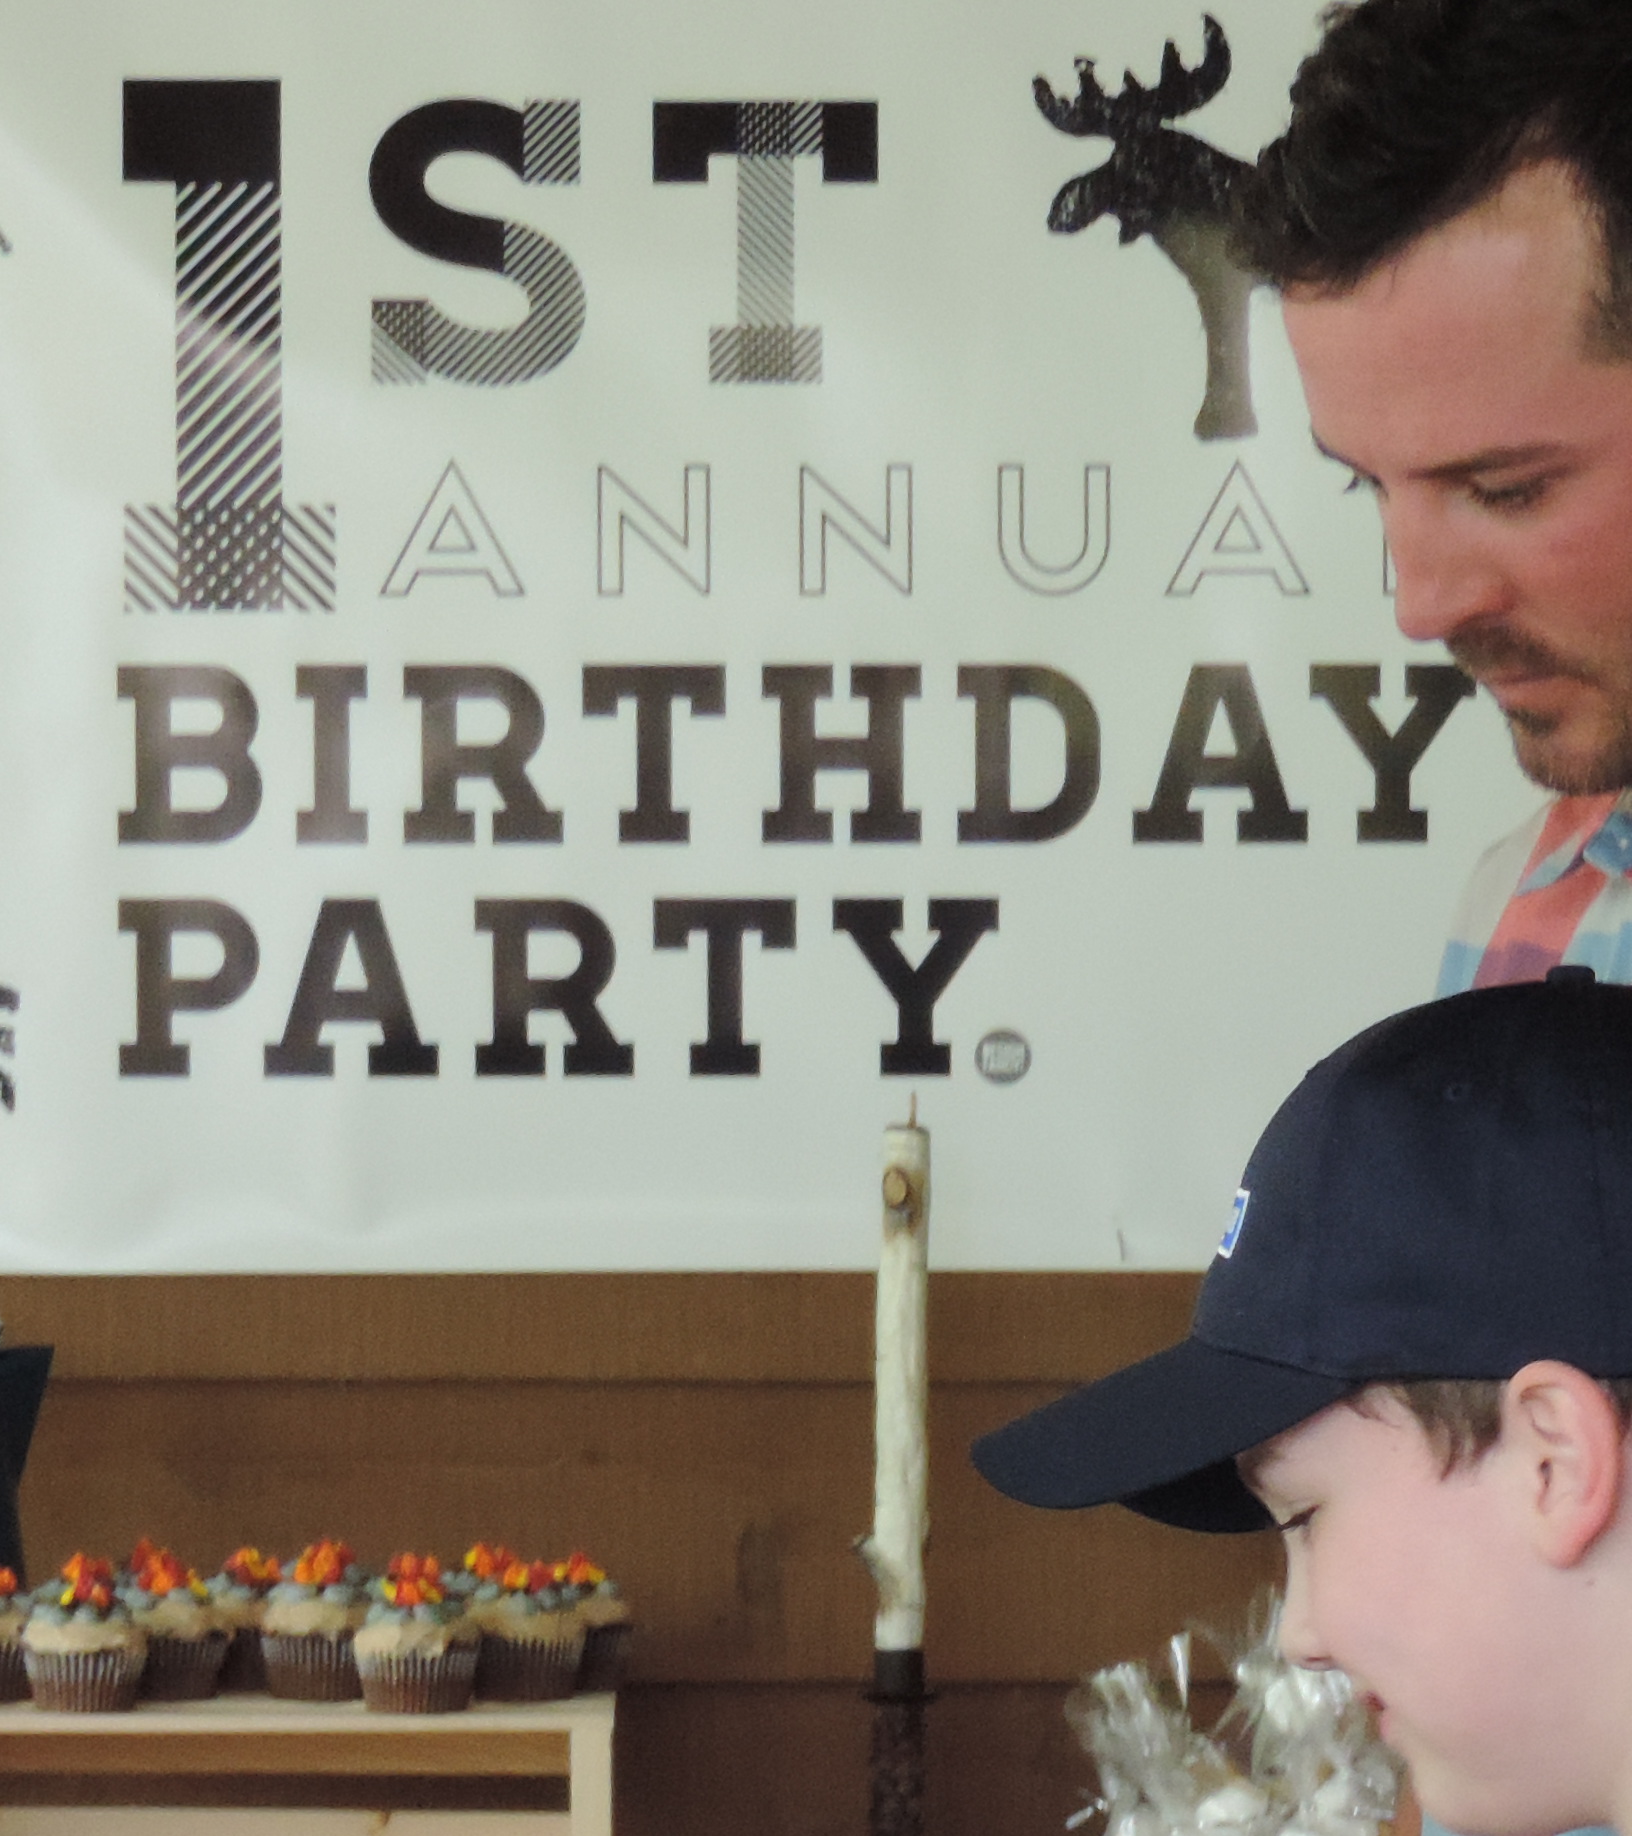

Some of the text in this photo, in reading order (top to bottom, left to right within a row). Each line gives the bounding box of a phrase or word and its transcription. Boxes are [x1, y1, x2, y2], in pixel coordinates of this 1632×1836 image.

[121, 78, 879, 613] 1ST
[377, 460, 1397, 598] ANNUA
[116, 663, 1477, 845] BIRTHDAY
[116, 897, 1000, 1077] PARTY
